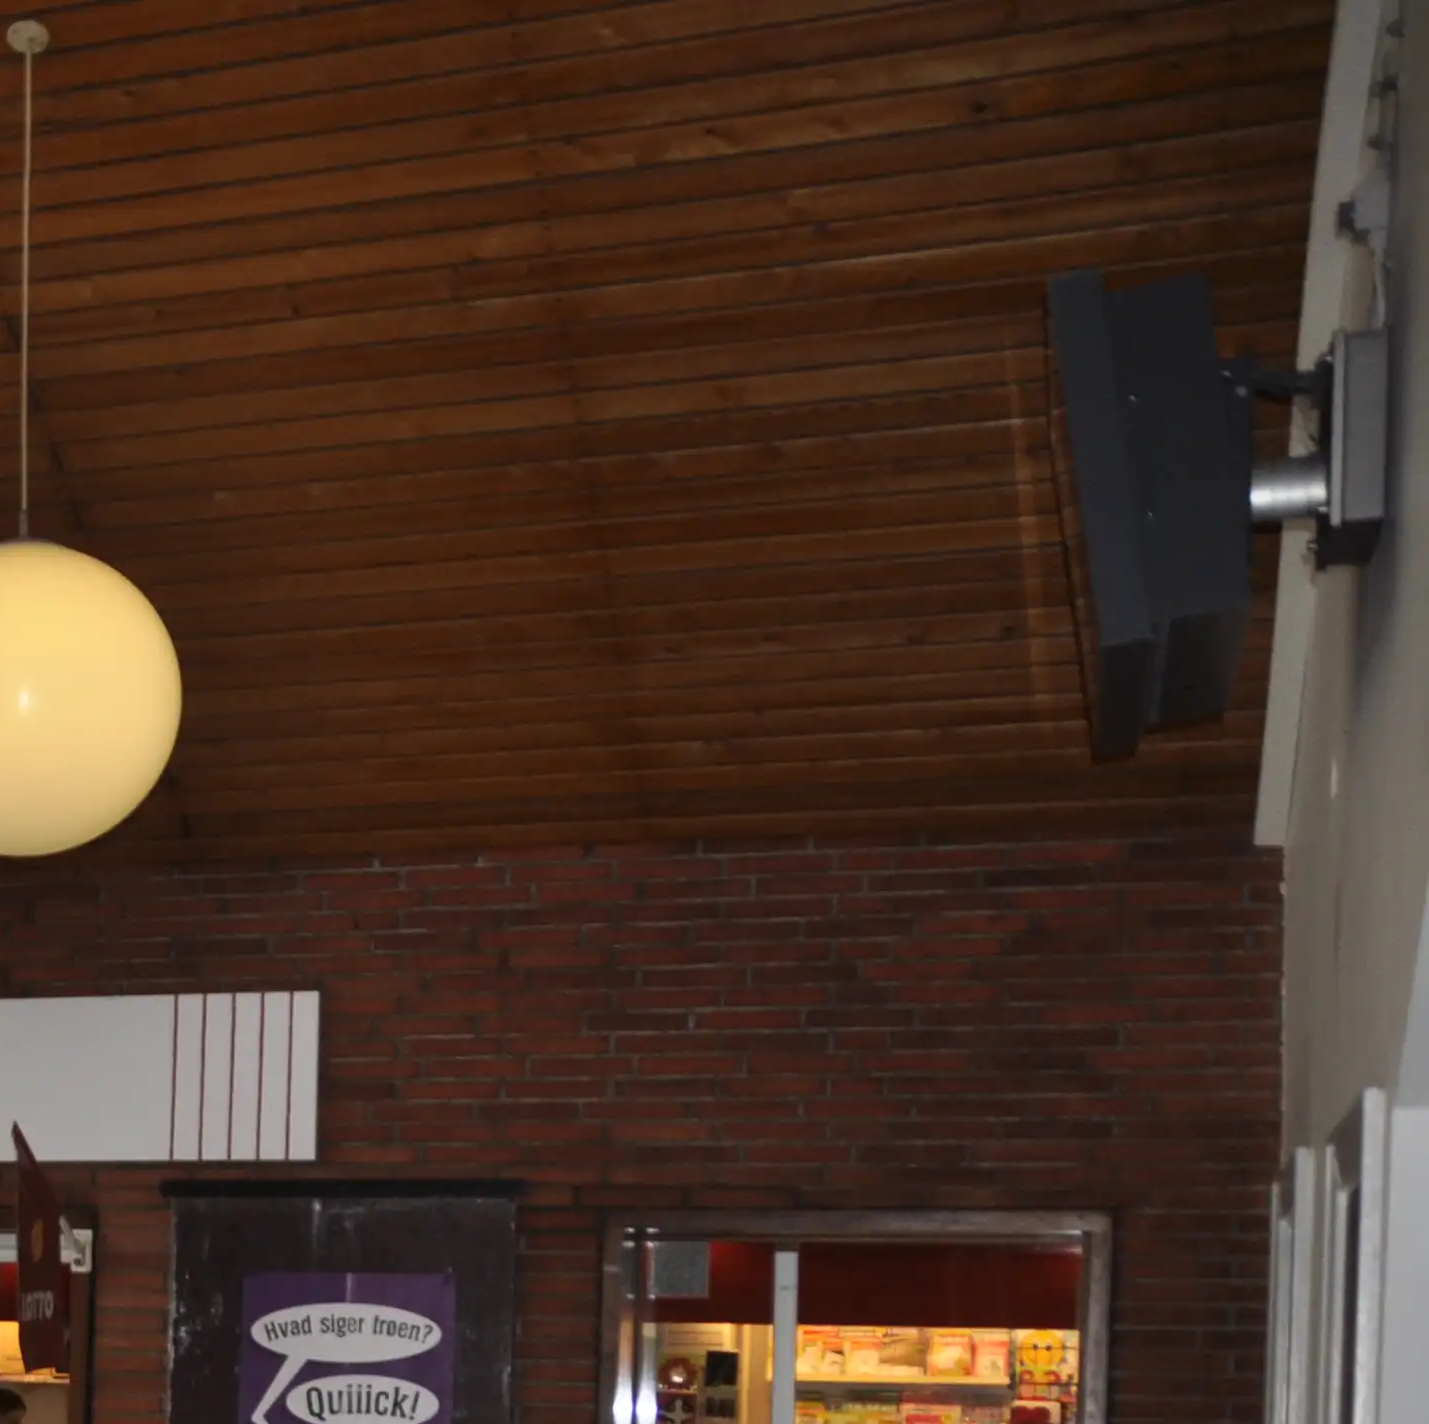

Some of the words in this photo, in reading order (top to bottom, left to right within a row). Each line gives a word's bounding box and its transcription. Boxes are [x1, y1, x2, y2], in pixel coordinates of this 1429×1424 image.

[263, 1315, 313, 1343] Hvad
[319, 1313, 365, 1338] siger
[305, 1384, 421, 1422] Quiiick!
